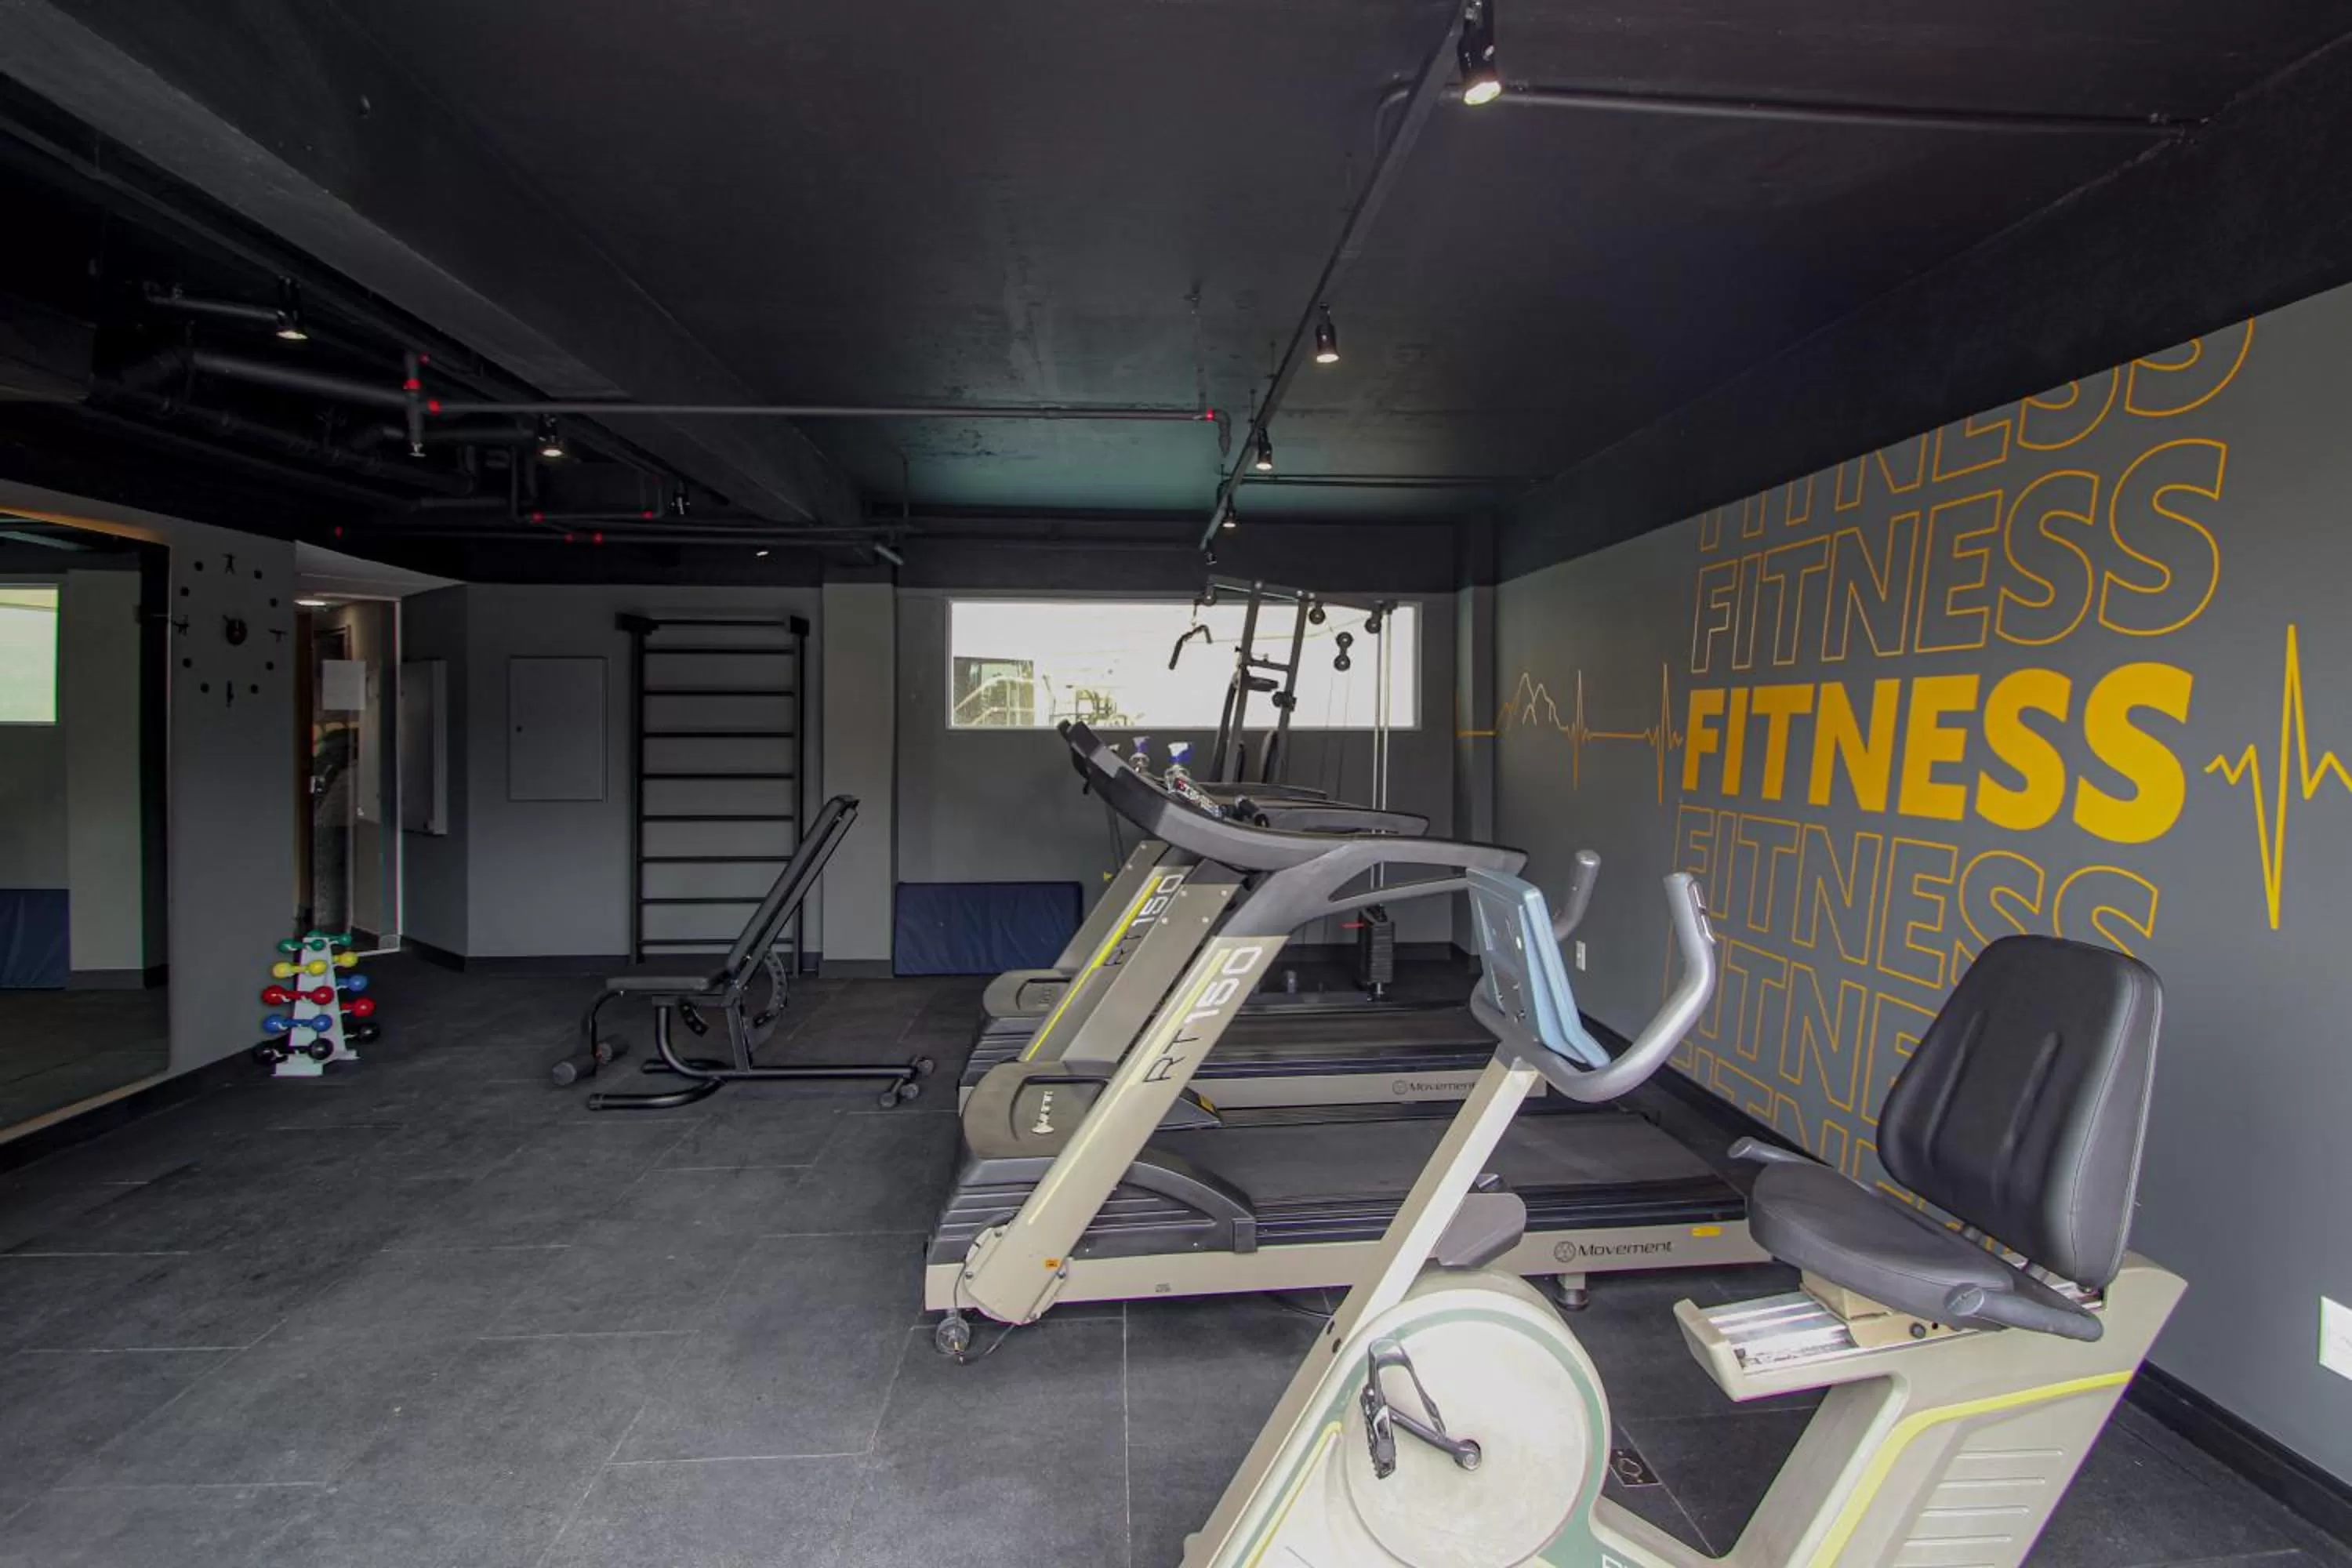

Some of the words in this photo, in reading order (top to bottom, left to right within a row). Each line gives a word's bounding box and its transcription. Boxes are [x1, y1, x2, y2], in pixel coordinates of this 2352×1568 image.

[1690, 437, 2227, 673] FITNESS
[1682, 661, 2194, 844] FITNESS
[1578, 1241, 1672, 1256] Movement
